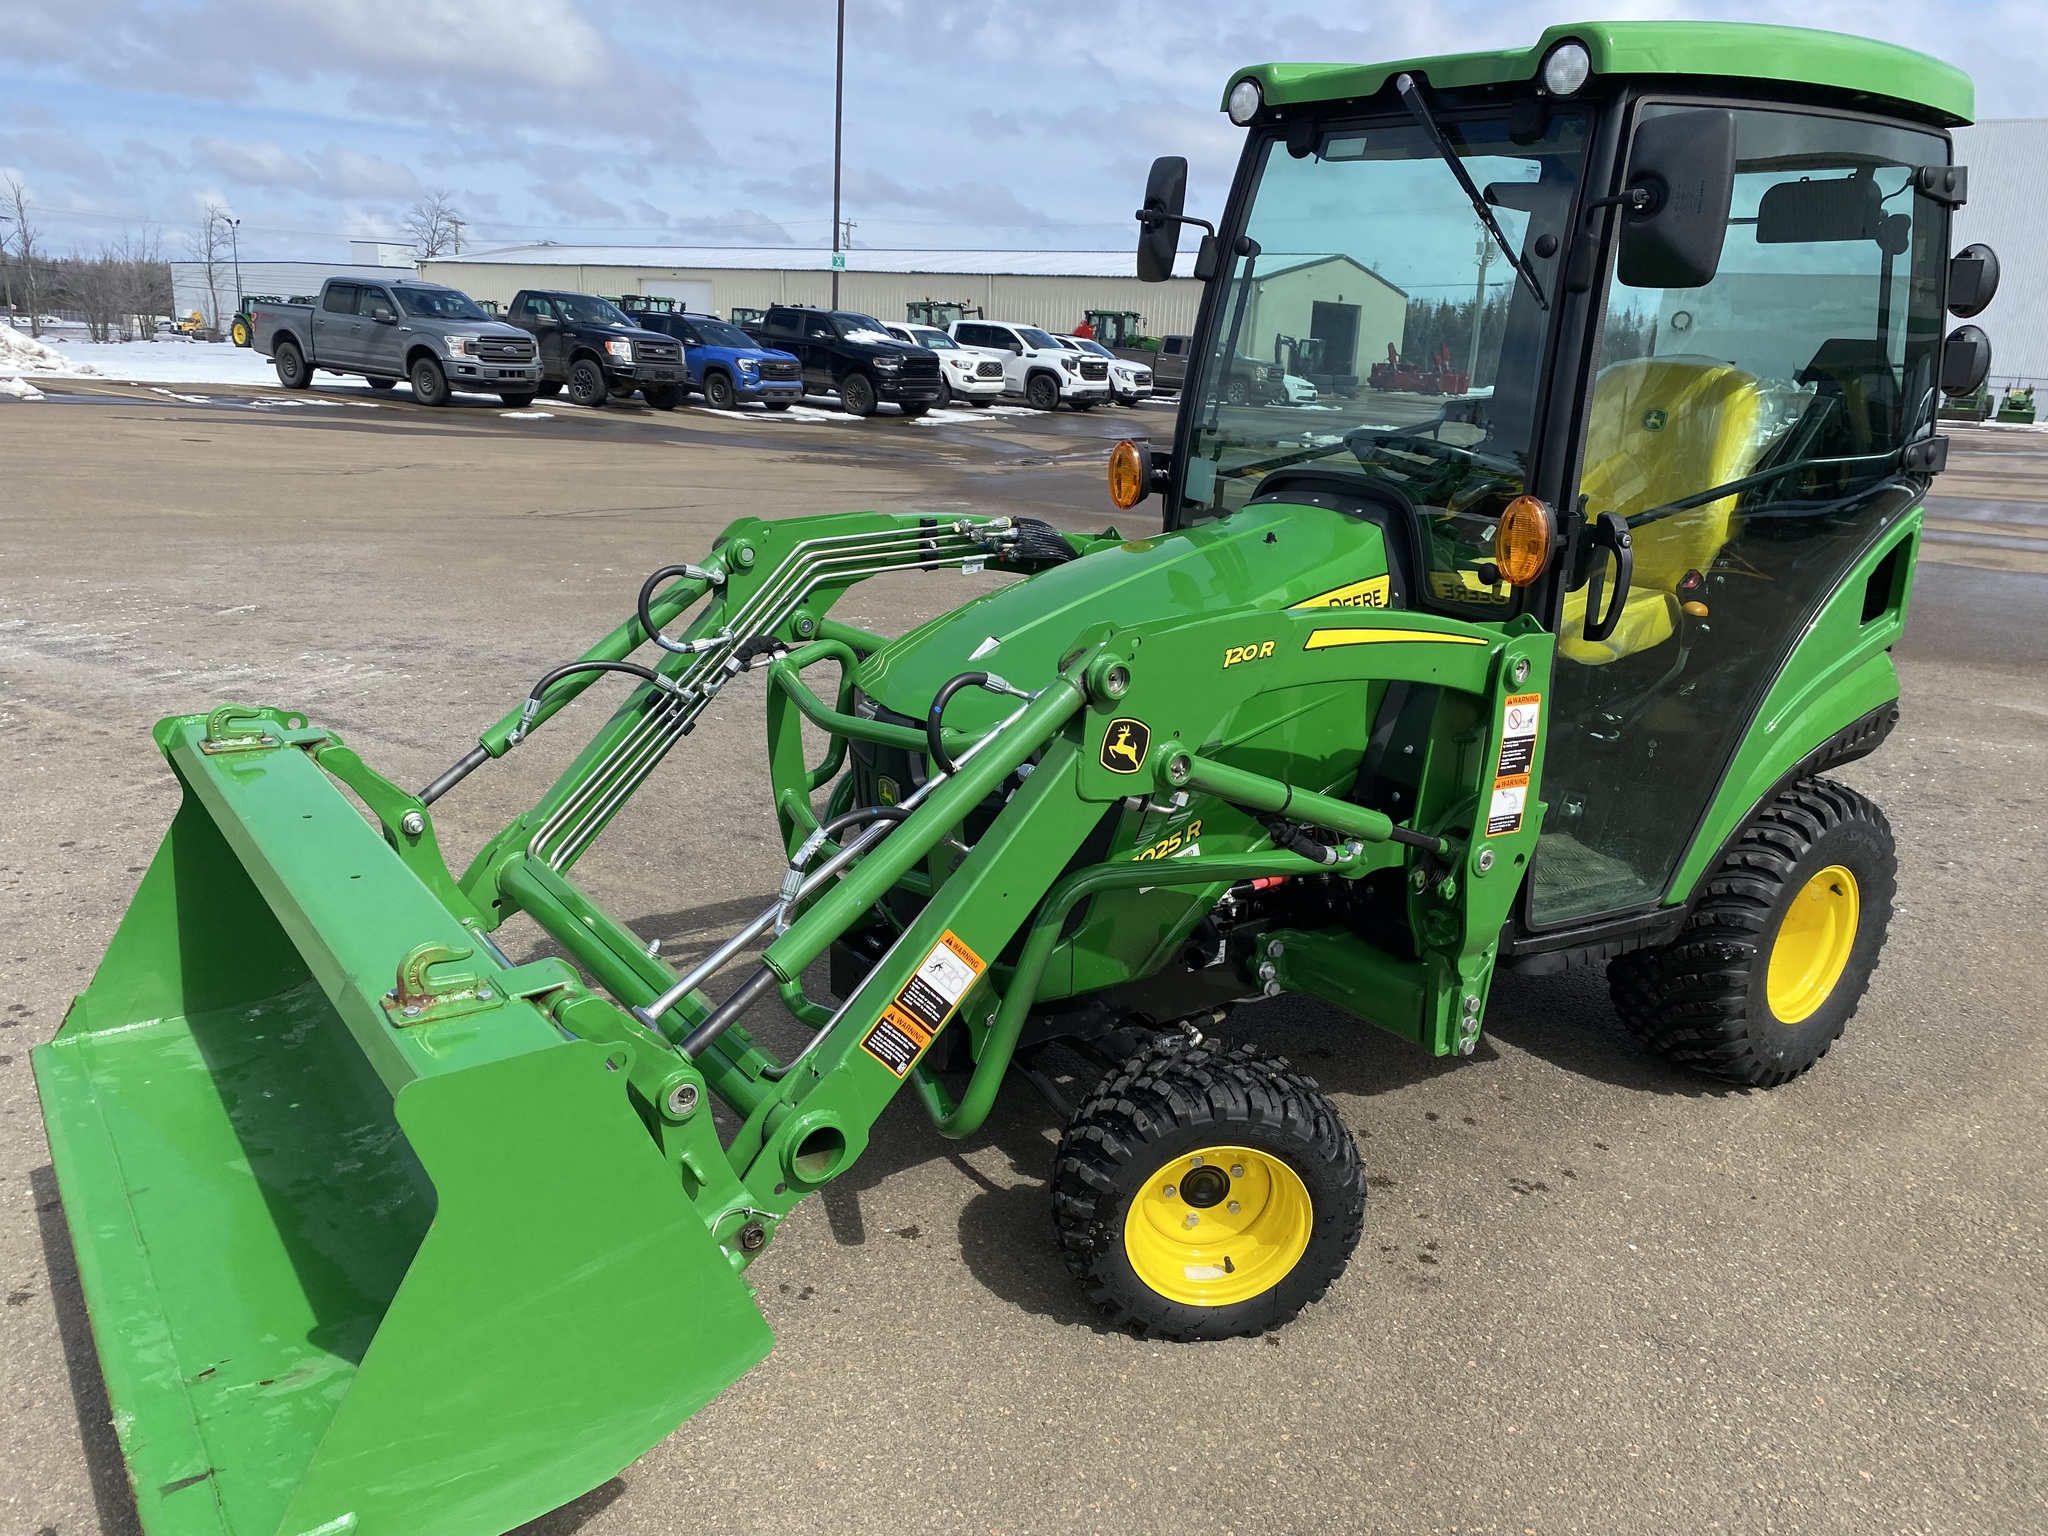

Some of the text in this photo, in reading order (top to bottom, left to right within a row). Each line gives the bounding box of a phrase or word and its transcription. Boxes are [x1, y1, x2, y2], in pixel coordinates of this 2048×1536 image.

[1512, 694, 1539, 704] WARNING
[1501, 777, 1527, 788] WARNING
[952, 942, 979, 969] WARNING
[896, 1016, 925, 1044] WARNING
